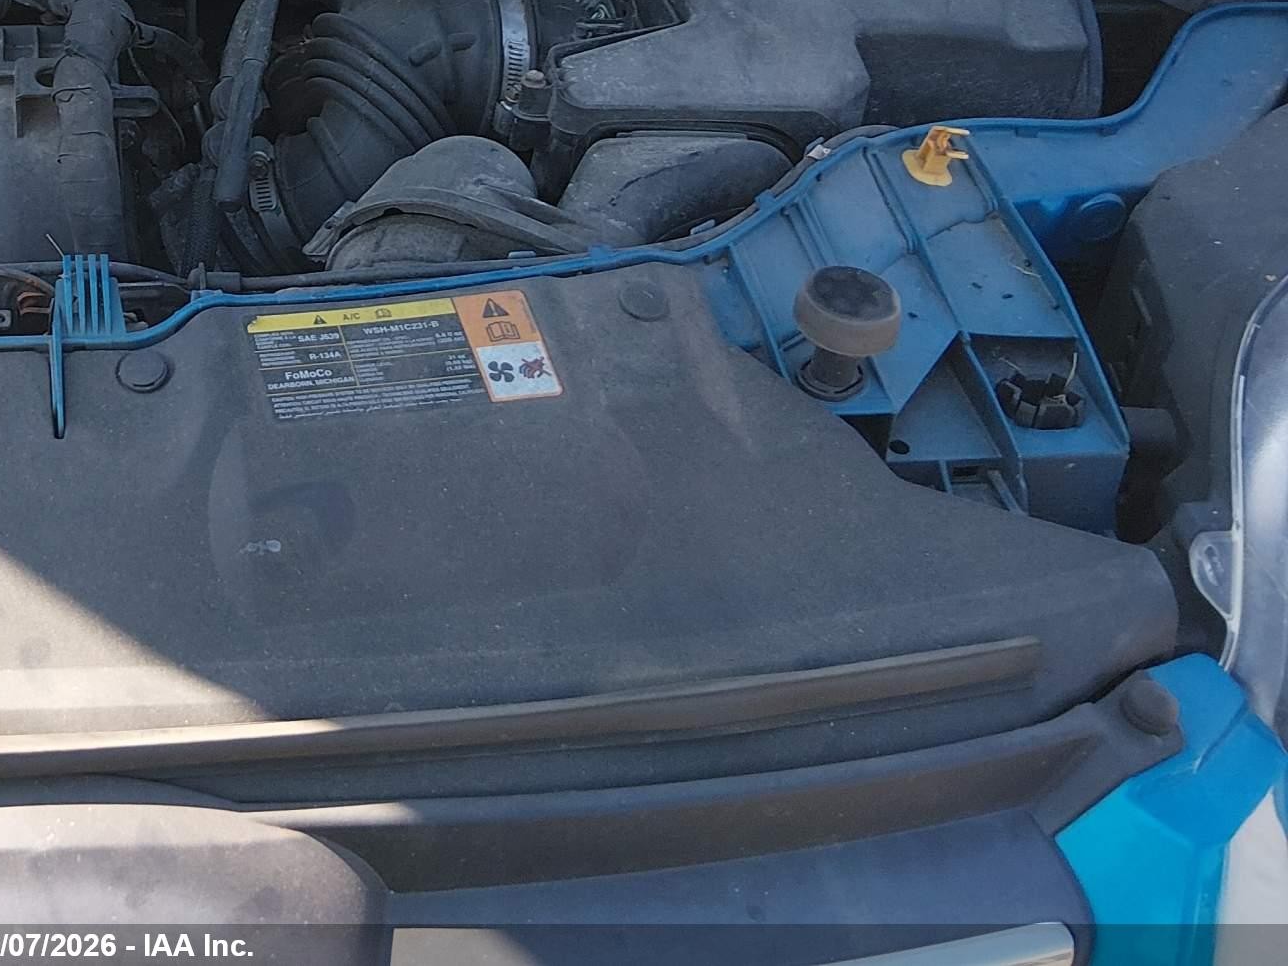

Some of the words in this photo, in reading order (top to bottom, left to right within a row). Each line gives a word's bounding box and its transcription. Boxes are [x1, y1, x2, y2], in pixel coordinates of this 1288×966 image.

[342, 312, 361, 321] A/C
[297, 335, 318, 343] SAE
[308, 351, 342, 360] R-134A
[284, 368, 333, 380] FoMoCo
